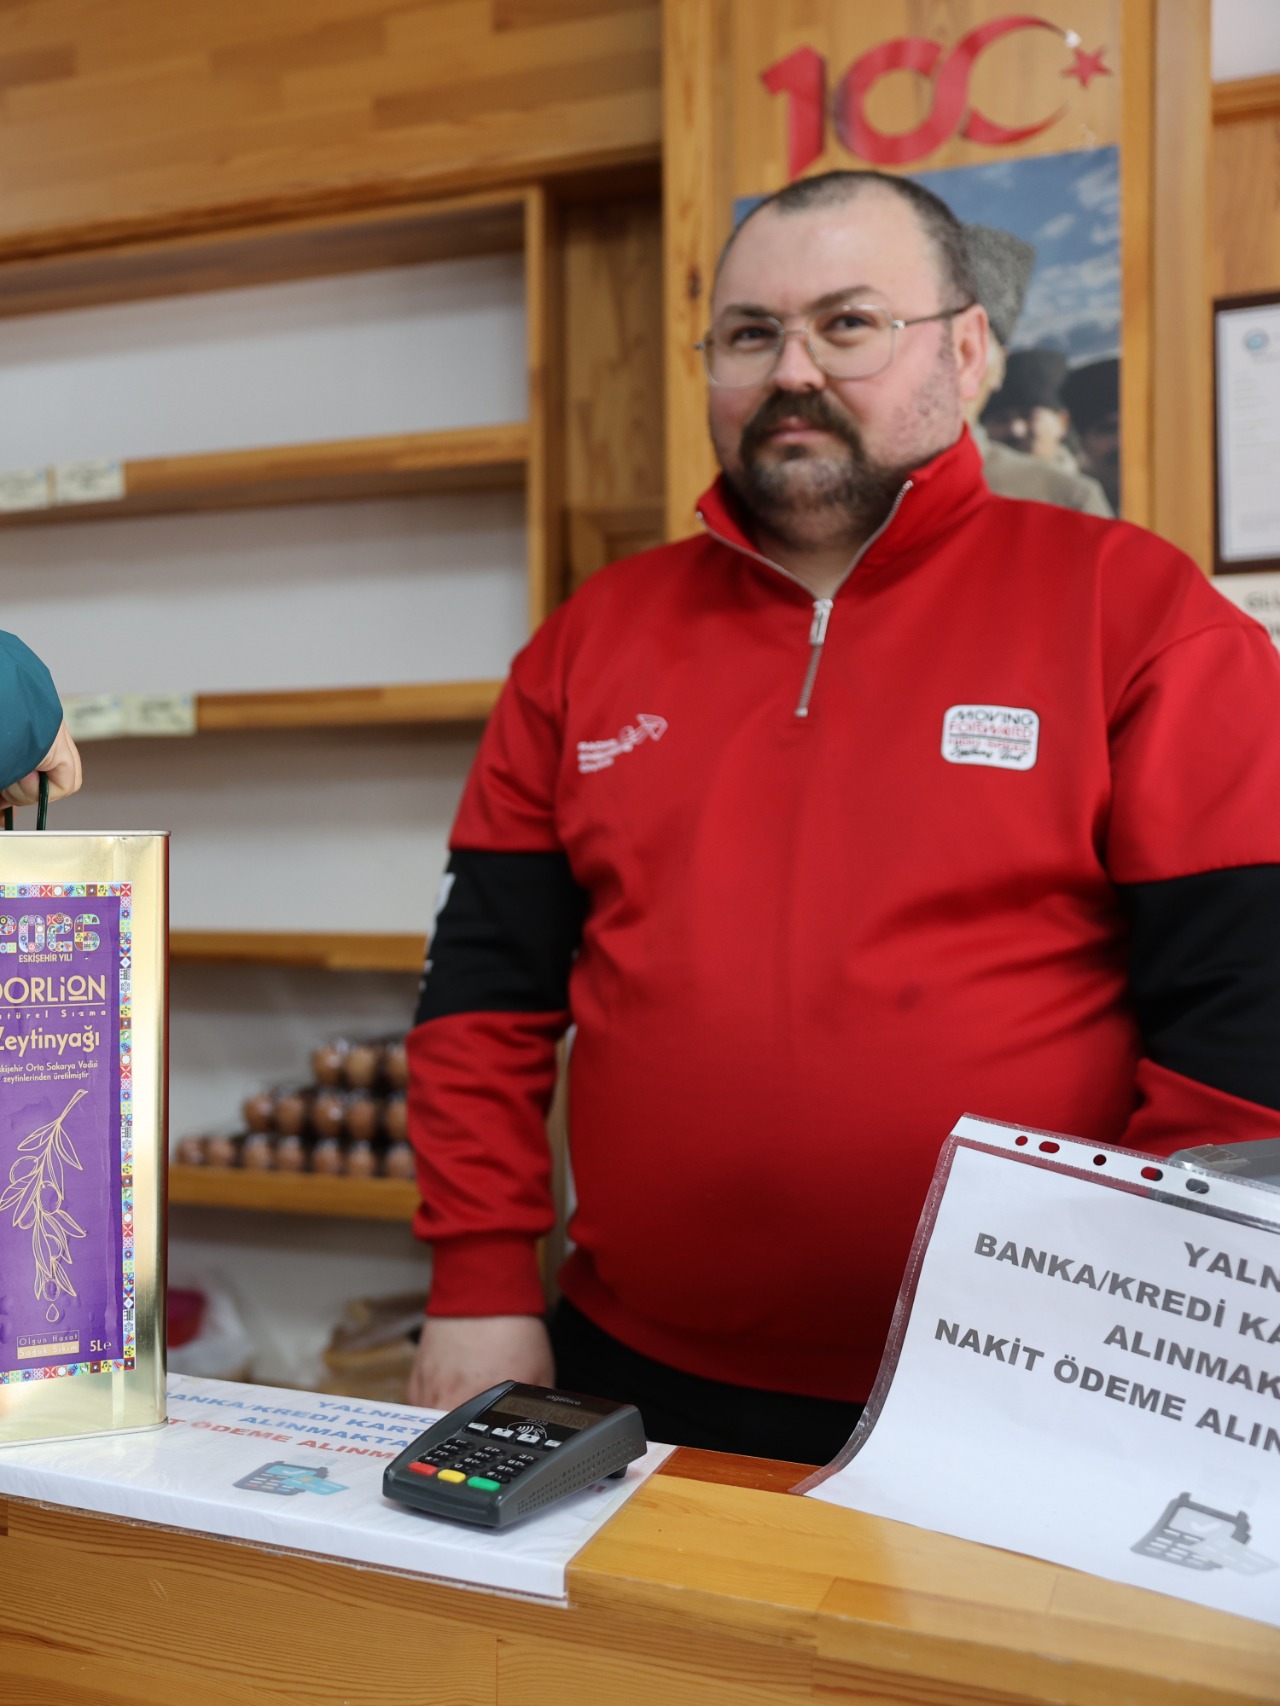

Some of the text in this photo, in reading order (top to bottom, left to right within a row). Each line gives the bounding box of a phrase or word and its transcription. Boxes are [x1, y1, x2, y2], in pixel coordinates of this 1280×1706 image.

[59, 953, 73, 962] YILI
[61, 1009, 107, 1018] Sızma
[25, 1063, 45, 1072] Orta
[46, 1061, 76, 1072] Sakarya
[78, 1060, 99, 1069] Vadisi
[3, 1073, 51, 1084] zeytinlerinden
[974, 1232, 1226, 1328] BANKA/KREDİ
[19, 1337, 48, 1346] Olgun
[935, 1318, 1045, 1371] NAKİT
[1054, 1354, 1187, 1422] ÖDEME
[190, 1420, 293, 1443] ÖDEME
